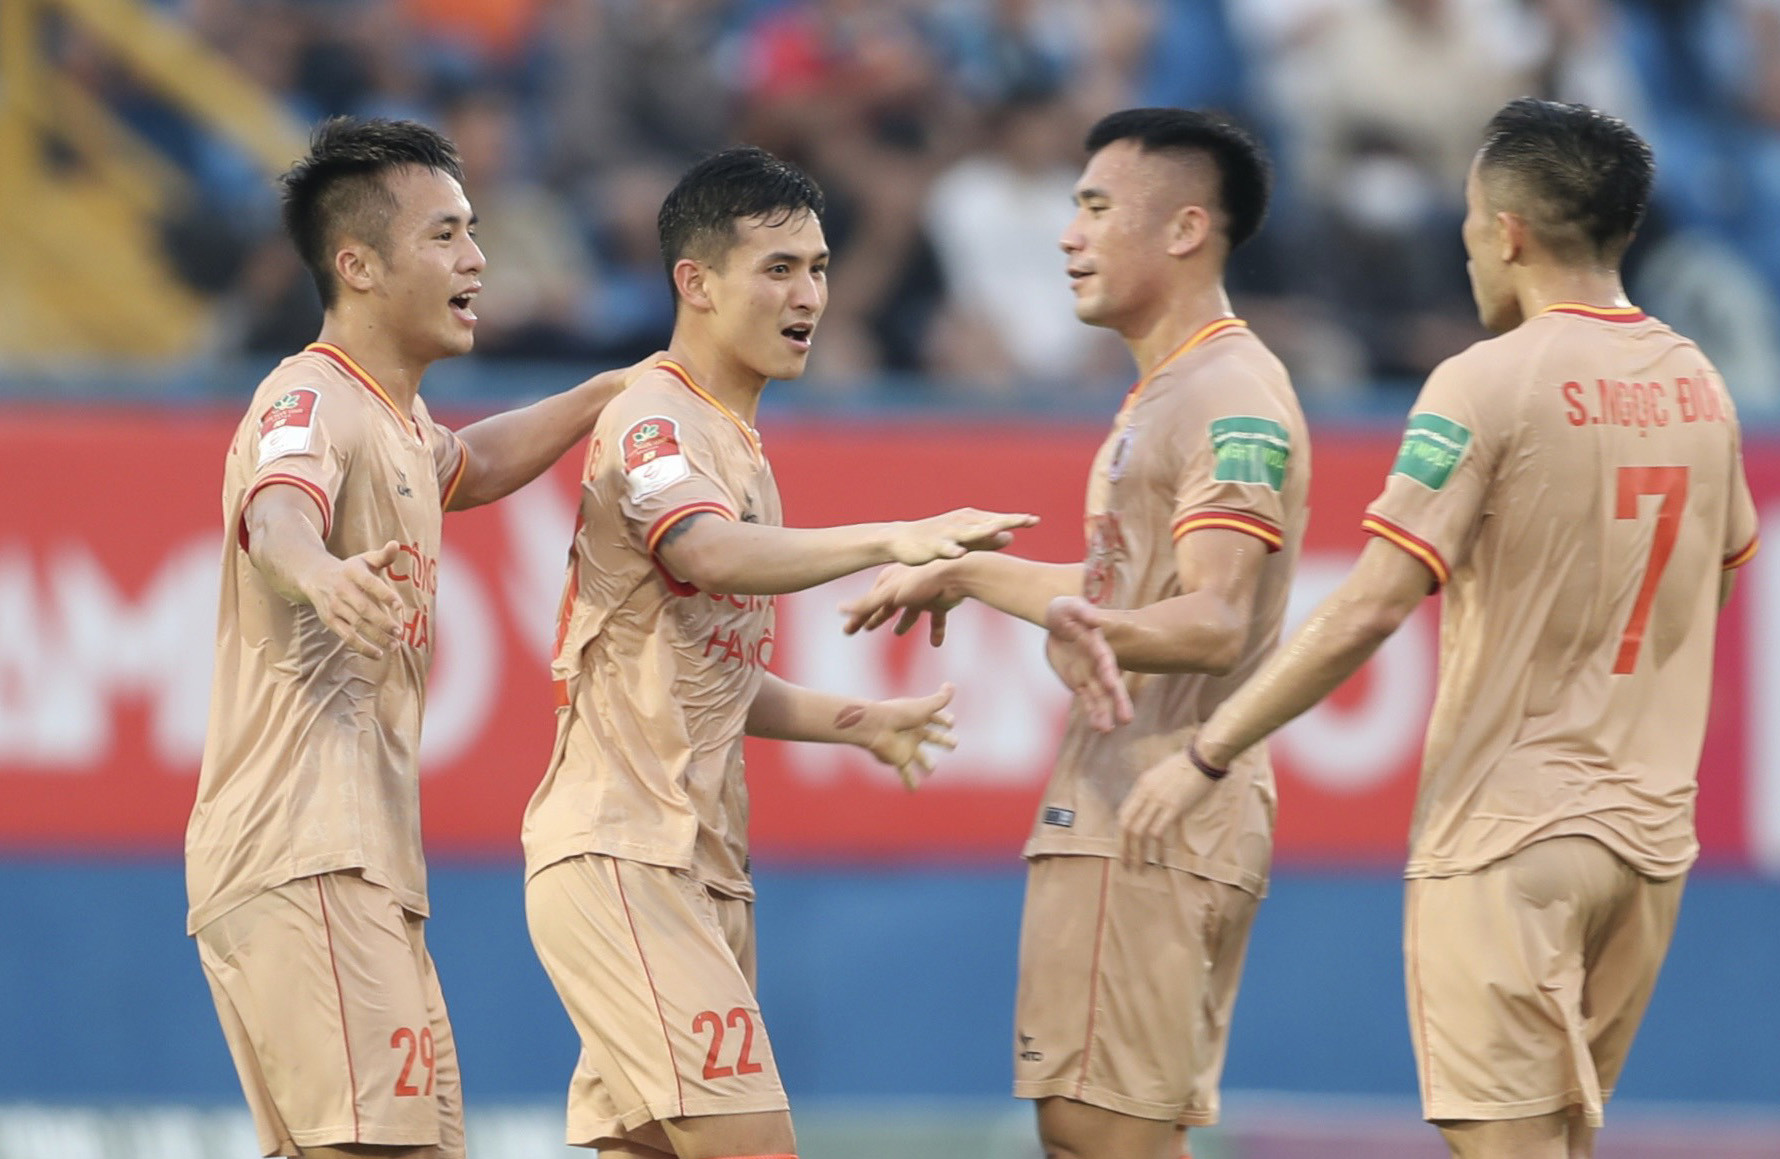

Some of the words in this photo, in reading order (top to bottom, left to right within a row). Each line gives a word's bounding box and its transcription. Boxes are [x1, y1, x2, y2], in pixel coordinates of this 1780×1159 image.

[1675, 368, 1727, 423] ĐỨ
[1612, 466, 1689, 674] 7
[390, 1027, 435, 1096] 29
[692, 1007, 762, 1080] 22
